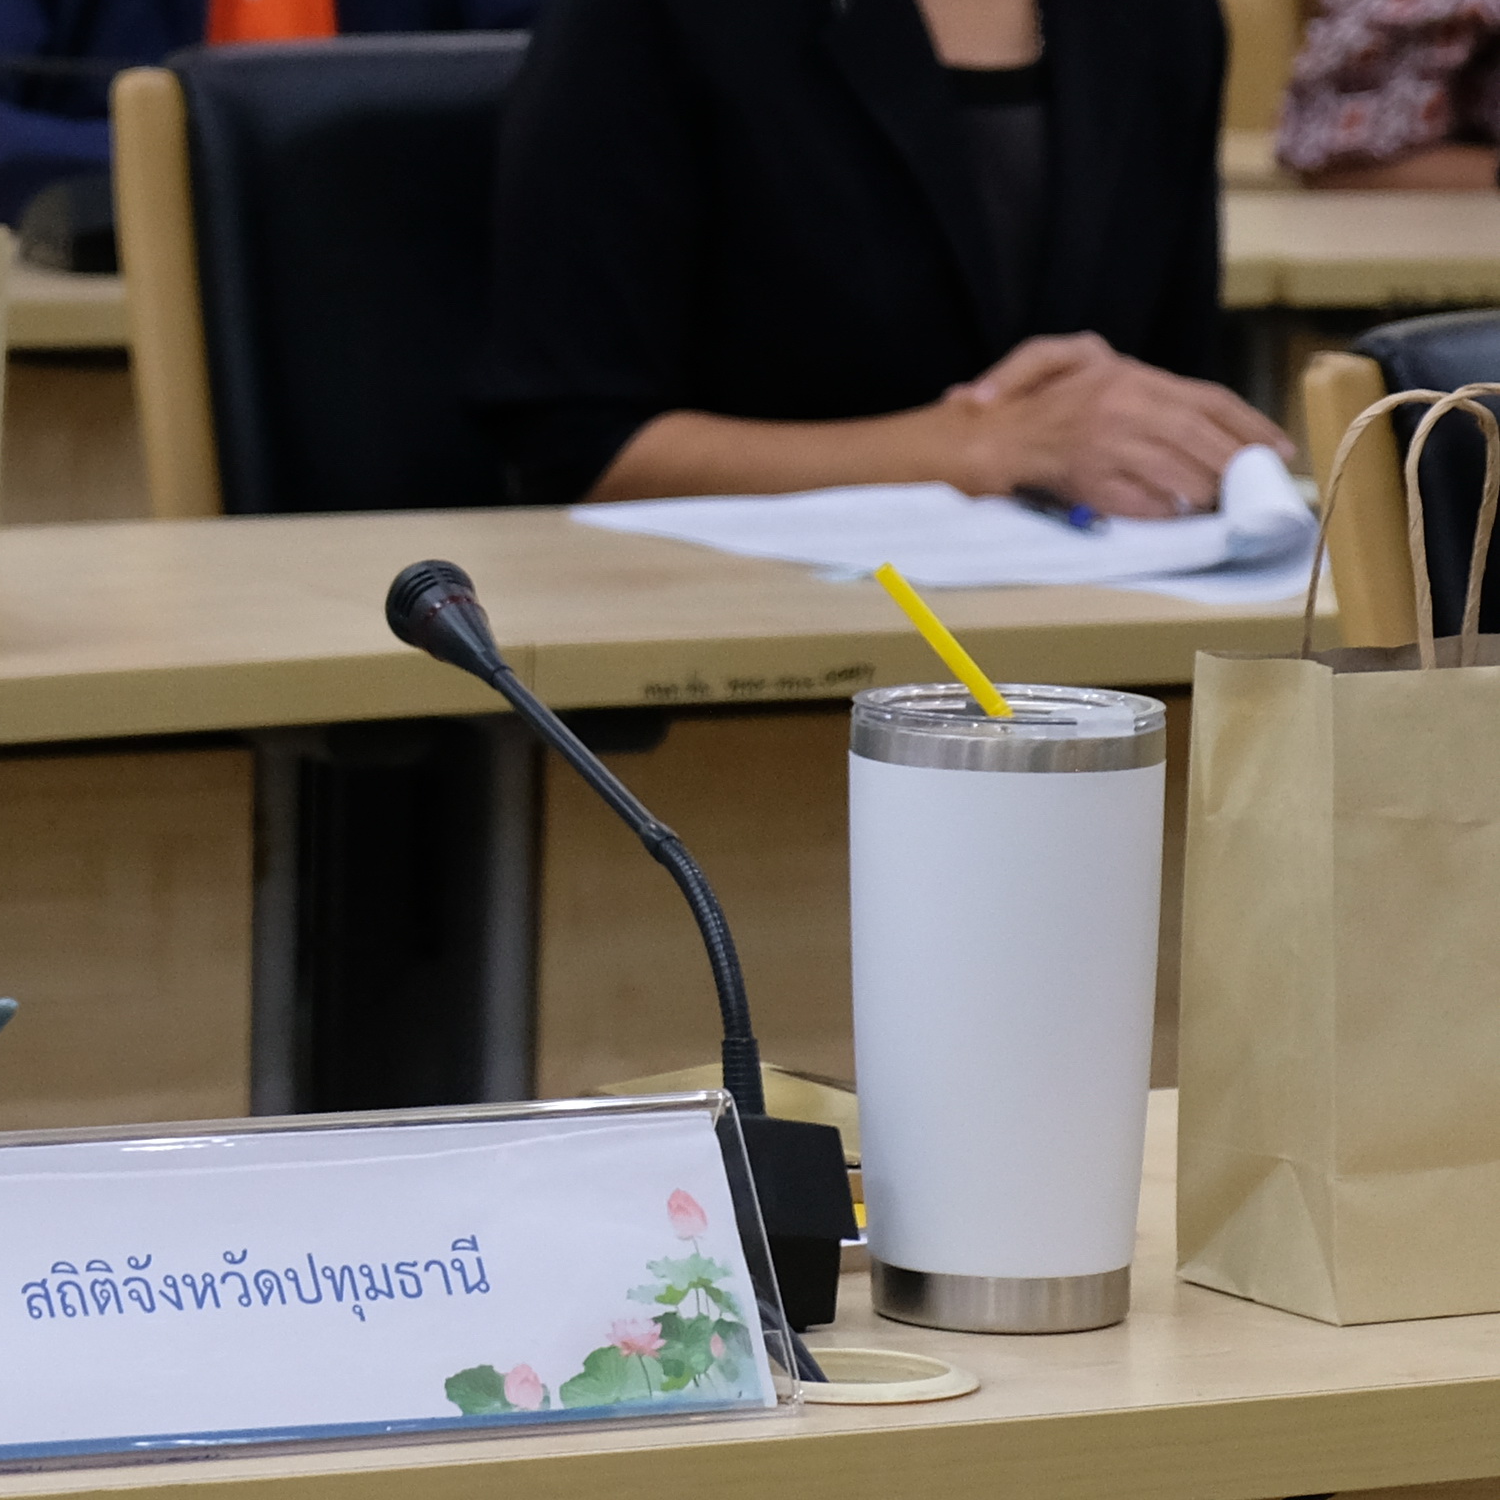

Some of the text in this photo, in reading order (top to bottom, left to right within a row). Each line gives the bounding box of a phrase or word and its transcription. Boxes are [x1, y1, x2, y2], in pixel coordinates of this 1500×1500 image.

[21, 1235, 491, 1322] สถิติจังหวัดปทุมธานี
